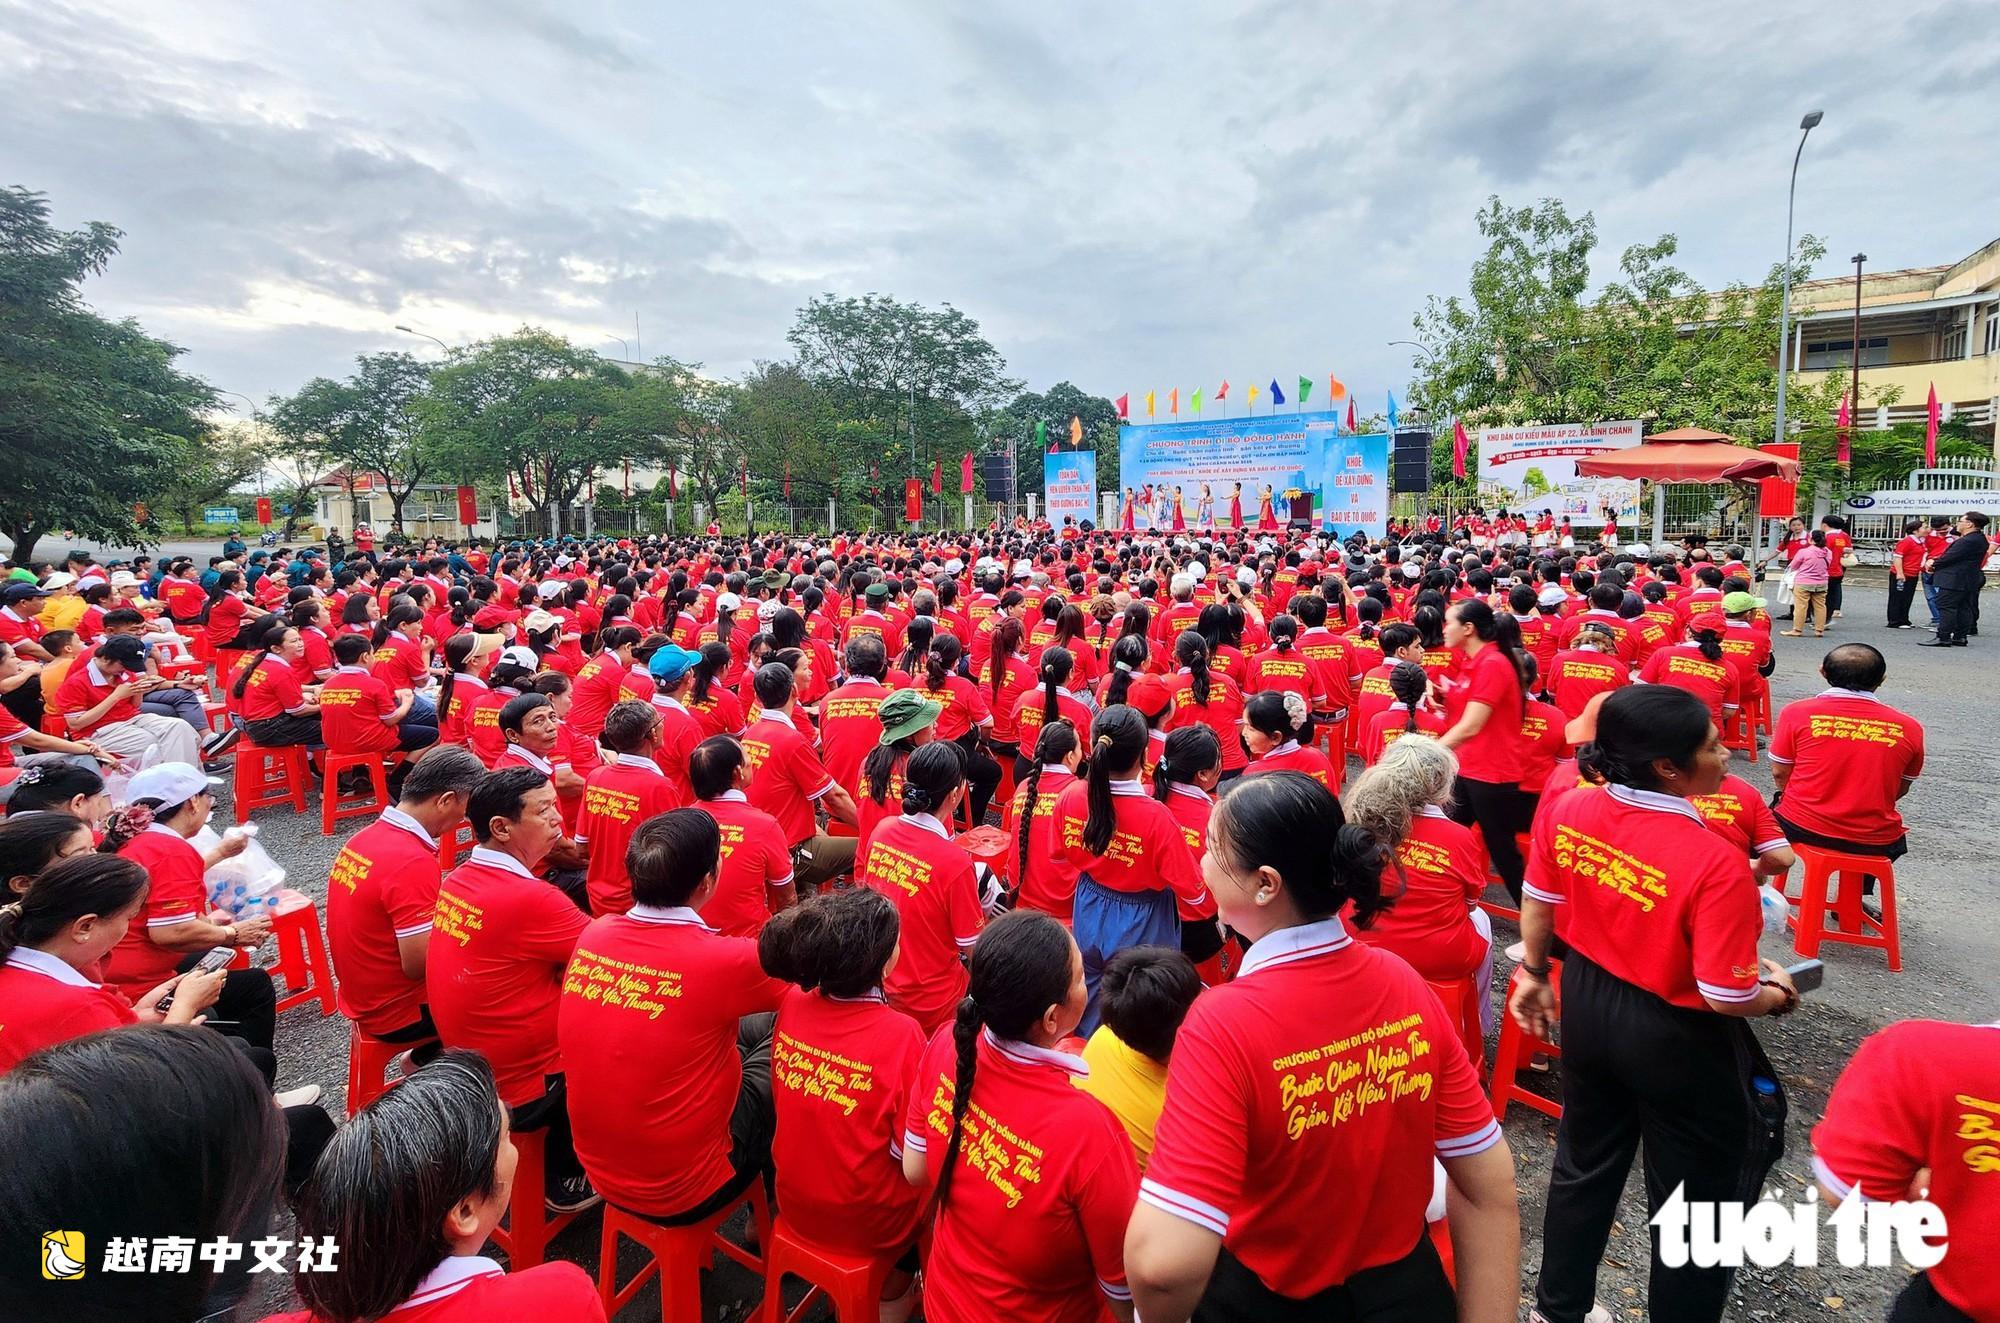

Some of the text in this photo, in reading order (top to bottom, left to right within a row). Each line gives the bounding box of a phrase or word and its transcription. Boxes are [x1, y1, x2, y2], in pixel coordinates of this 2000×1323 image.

[1146, 439, 1184, 449] CHƯƠNG
[1487, 433, 1500, 441] KHU
[1500, 431, 1514, 440] DÂN
[1608, 425, 1633, 435] CHÁNH
[589, 965, 615, 984] Chân
[615, 973, 652, 996] Nghĩa
[655, 980, 683, 998] Tình
[635, 964, 657, 977] ĐỒNG
[657, 968, 682, 981] HÀNH
[582, 982, 602, 1001] Kết
[601, 986, 623, 1007] Yêu
[622, 992, 666, 1020] Thương
[831, 1054, 851, 1067] ĐỒNG
[851, 1060, 873, 1073] HÀNH
[1272, 1049, 1321, 1071] CHƯƠNG
[1321, 1038, 1351, 1058] TRÌNH
[1350, 1034, 1361, 1048] ĐI
[1361, 1028, 1376, 1045] BỘ
[1376, 1020, 1402, 1038] ĐỒNG
[788, 1052, 814, 1072] Chân
[848, 1073, 873, 1092] Tình
[1280, 1072, 1326, 1112] Bước
[1326, 1056, 1362, 1093] Chân
[1365, 1045, 1411, 1084] Nghĩa
[785, 1070, 804, 1090] Kết
[804, 1075, 823, 1097] Yêu
[823, 1083, 858, 1116] Thương
[1287, 1071, 1433, 1141] Gắn Kết Yêu Thương
[928, 1109, 948, 1136] Gắn
[966, 1141, 987, 1172] Yêu
[986, 1160, 1024, 1209] Thương
[979, 1129, 1011, 1169] Nghĩa
[1013, 1154, 1041, 1184] Tình
[996, 1123, 1018, 1145] ĐỒNG
[1017, 1138, 1043, 1159] HÀNH
